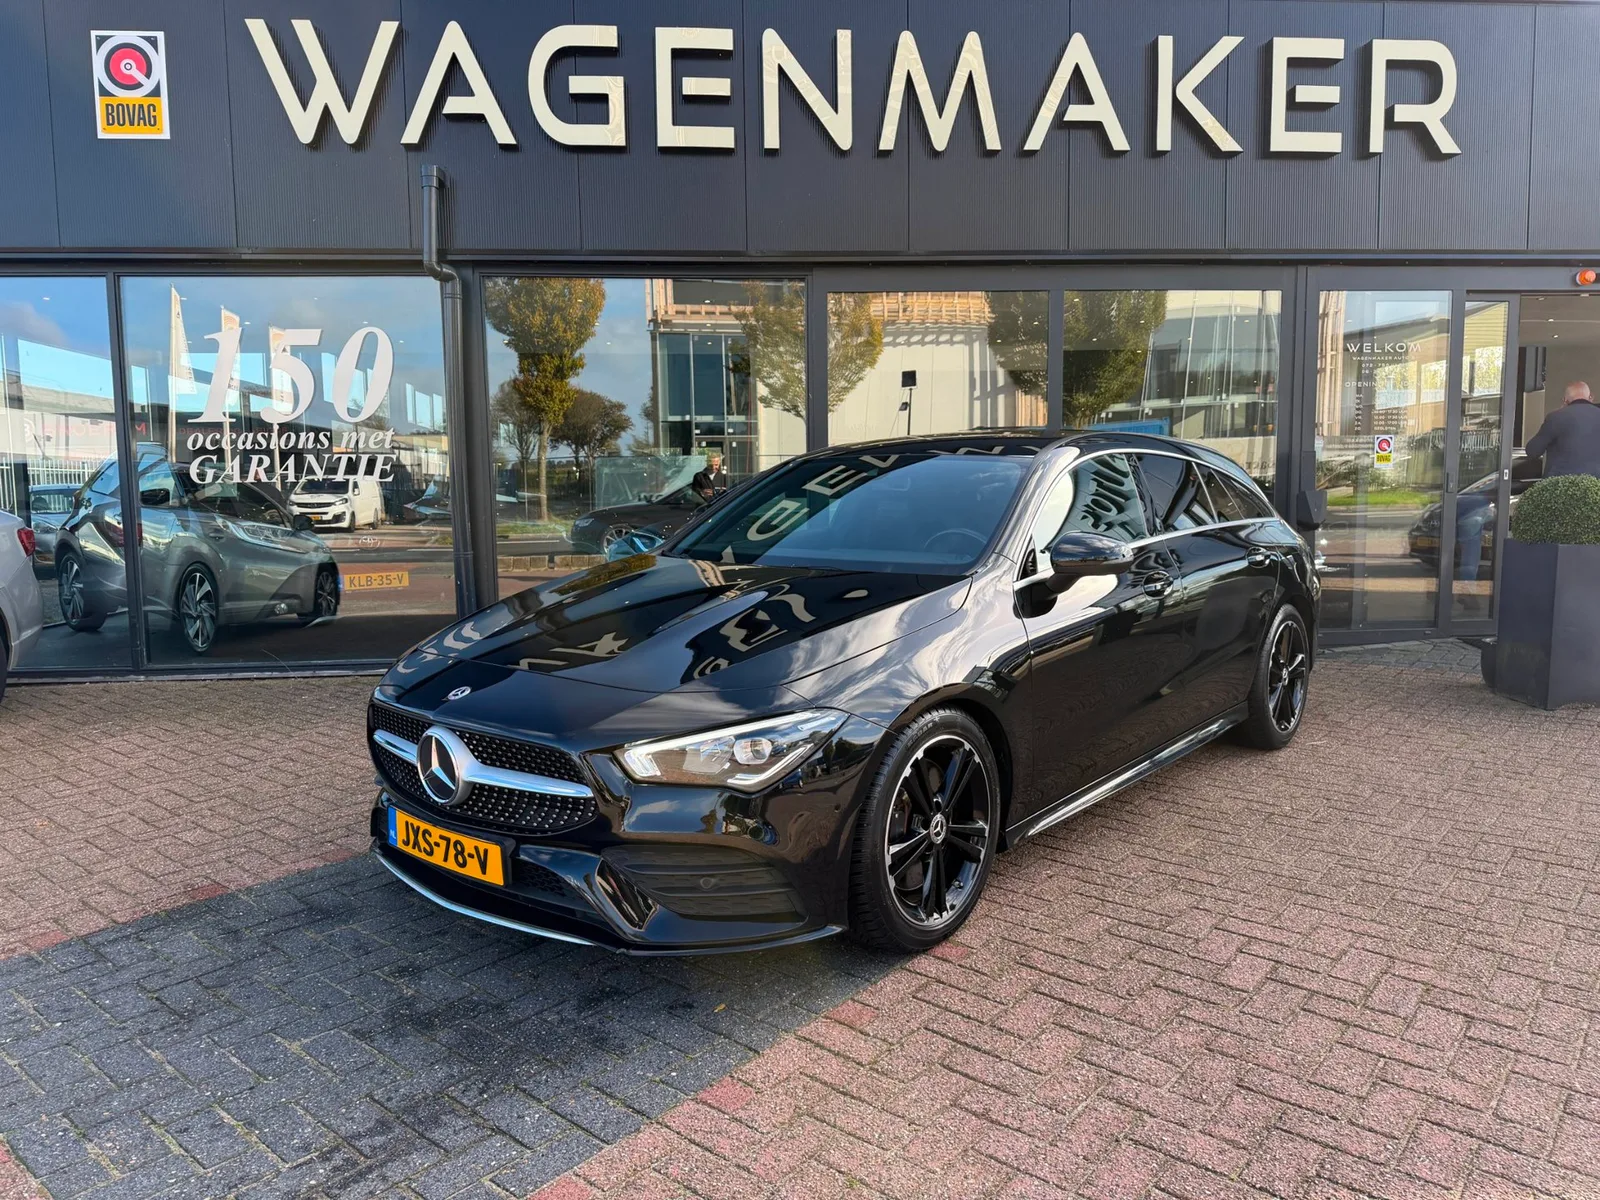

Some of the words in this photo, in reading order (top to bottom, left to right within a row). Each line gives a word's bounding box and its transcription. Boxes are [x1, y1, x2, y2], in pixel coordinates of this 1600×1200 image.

[244, 18, 1462, 156] WAGENMAKER
[104, 102, 158, 128] BOVAG
[1346, 342, 1422, 353] WELKOM
[186, 326, 394, 424] 150
[186, 424, 332, 451] occasions
[340, 425, 396, 450] met
[188, 453, 397, 484] GARANTIE
[348, 573, 404, 588] KLB-35-V
[401, 820, 489, 876] JXS-78-V
